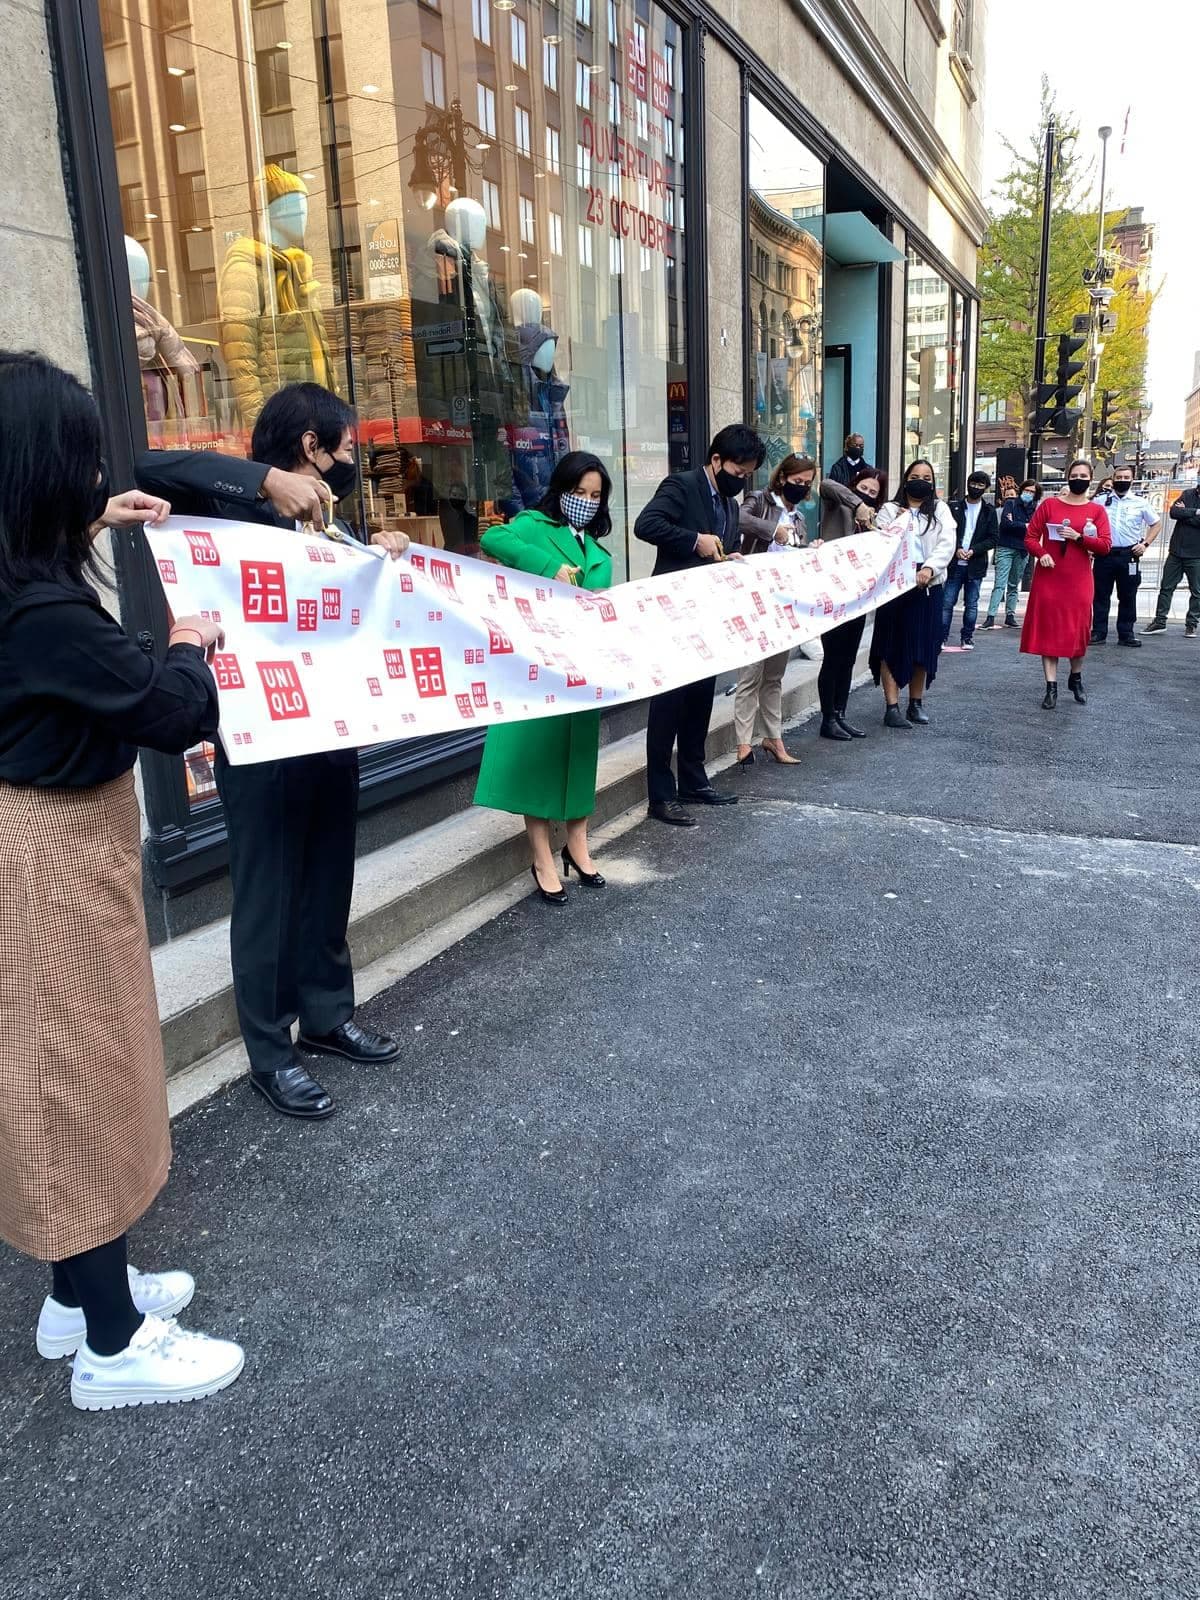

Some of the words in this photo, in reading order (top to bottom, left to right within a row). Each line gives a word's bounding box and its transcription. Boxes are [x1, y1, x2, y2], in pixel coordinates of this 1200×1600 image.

[582, 116, 673, 201] OUVERTURE
[586, 184, 604, 226] 23
[610, 195, 673, 257] OCTOBRE
[187, 535, 214, 548] UNI
[194, 548, 217, 563] QLO
[432, 565, 452, 586] UNI
[323, 591, 339, 604] UNI
[324, 604, 340, 618] QLO
[385, 652, 401, 664] UNI
[262, 667, 296, 689] UNI
[388, 665, 404, 676] QLO
[271, 691, 304, 717] QLO
